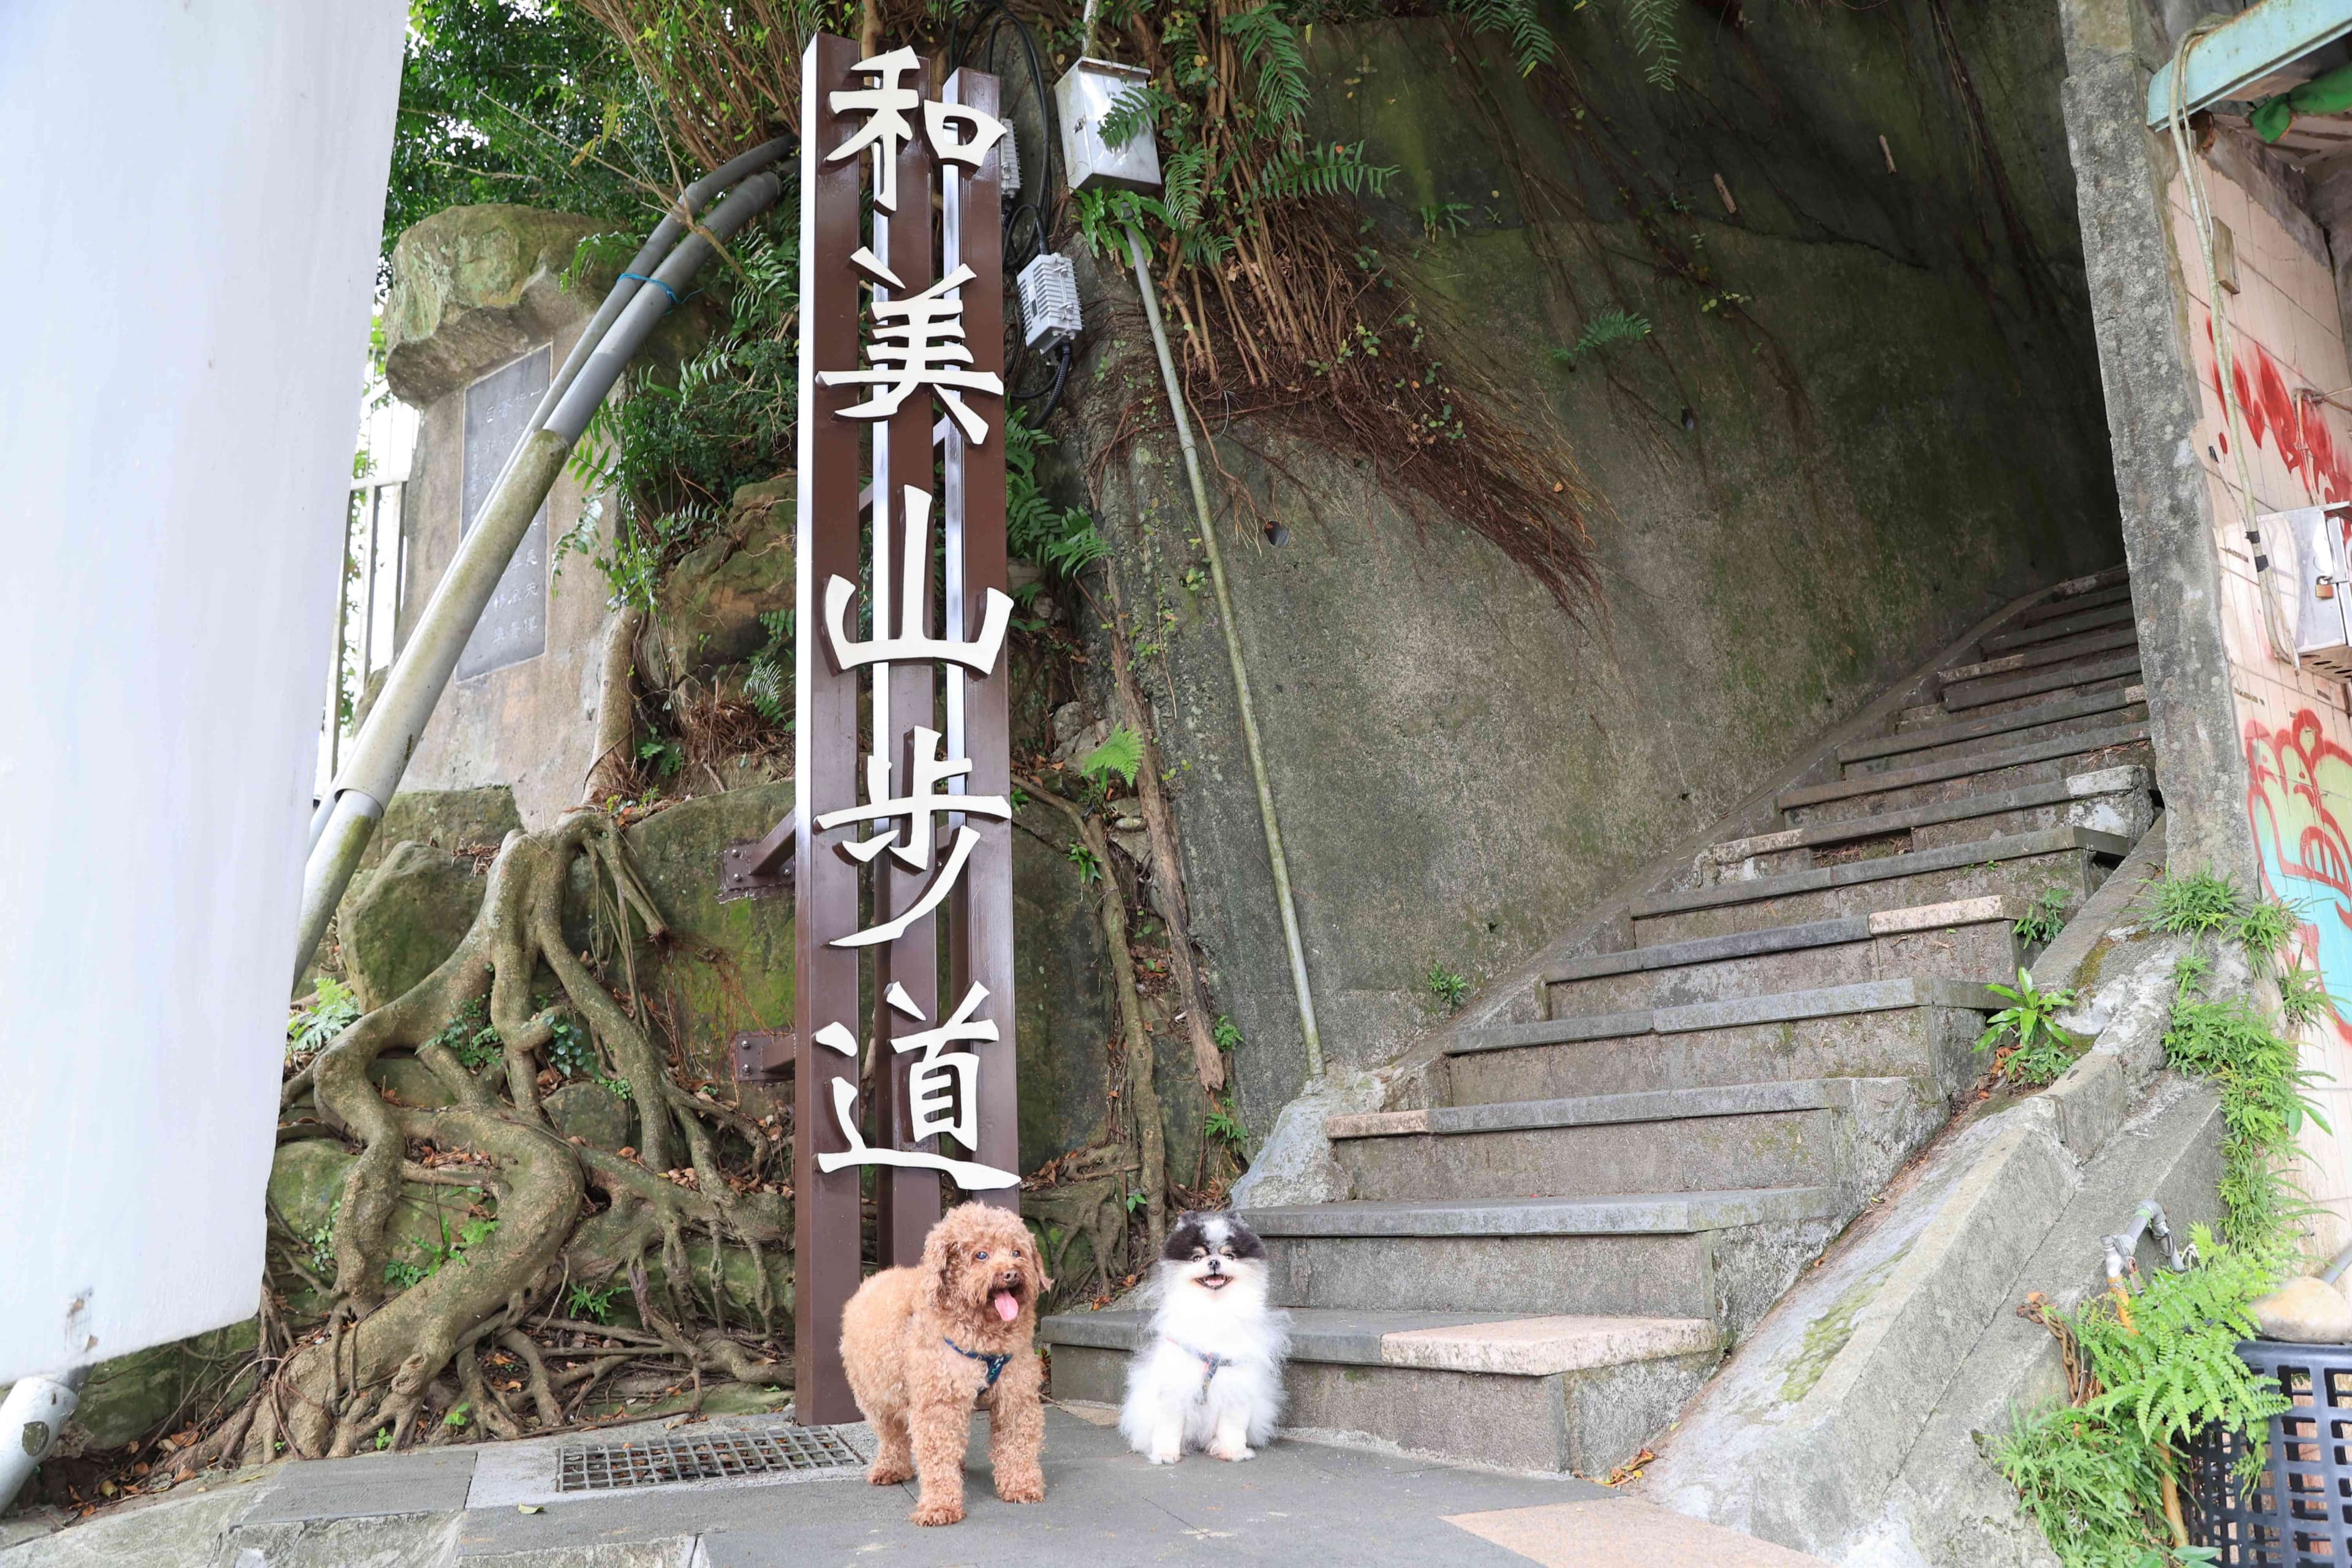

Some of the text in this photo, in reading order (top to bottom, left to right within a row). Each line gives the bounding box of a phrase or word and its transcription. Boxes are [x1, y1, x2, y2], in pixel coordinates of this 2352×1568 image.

[815, 46, 1021, 1189] 和美山步道
